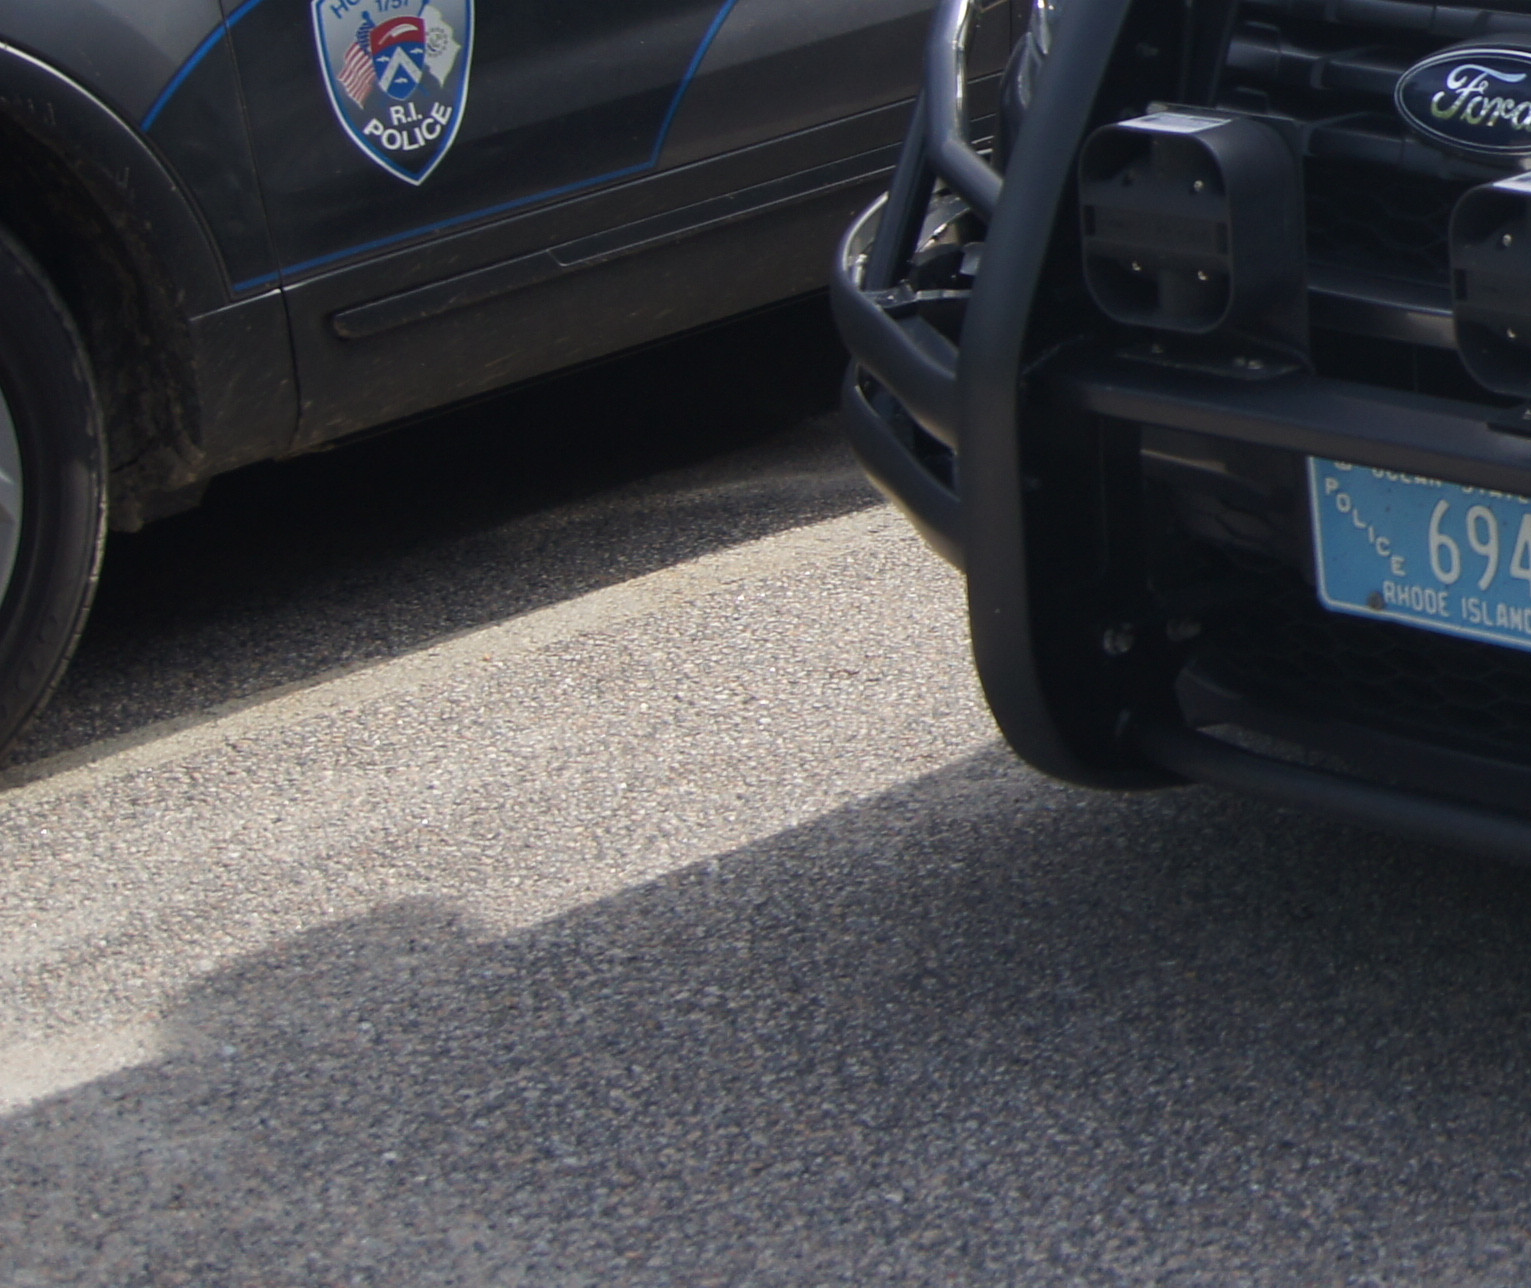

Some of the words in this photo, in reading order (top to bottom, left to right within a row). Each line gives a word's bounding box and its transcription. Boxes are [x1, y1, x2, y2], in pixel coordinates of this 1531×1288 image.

[363, 101, 453, 151] POLICE
[390, 102, 423, 126] R.I.
[1324, 477, 1406, 577] POLICE
[1382, 580, 1451, 618] RHODE
